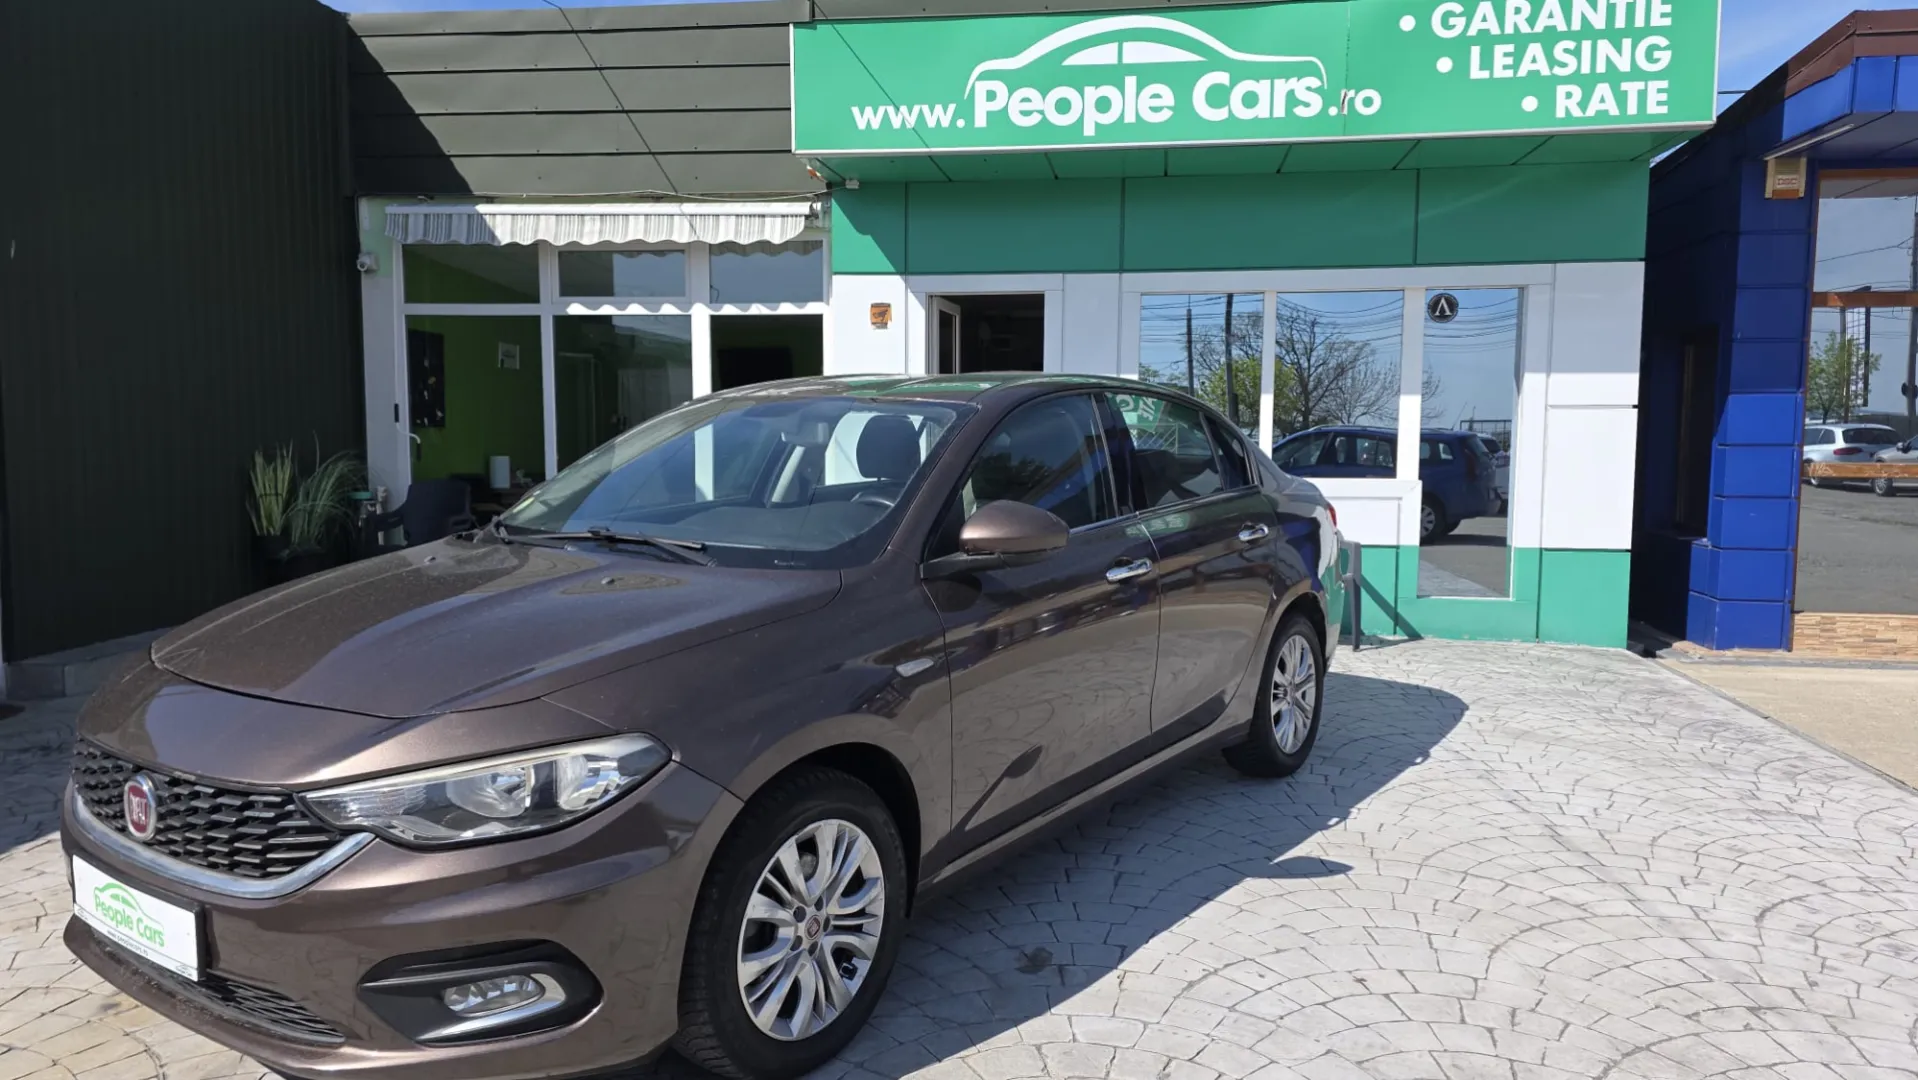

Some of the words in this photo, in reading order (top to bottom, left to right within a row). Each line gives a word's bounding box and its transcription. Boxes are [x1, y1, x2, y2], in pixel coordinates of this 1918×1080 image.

[1431, 0, 1672, 38] GARANTIE
[1469, 35, 1672, 80] LEASING
[1555, 80, 1669, 118] RATE
[94, 894, 134, 932] People
[136, 917, 165, 948] Cars
